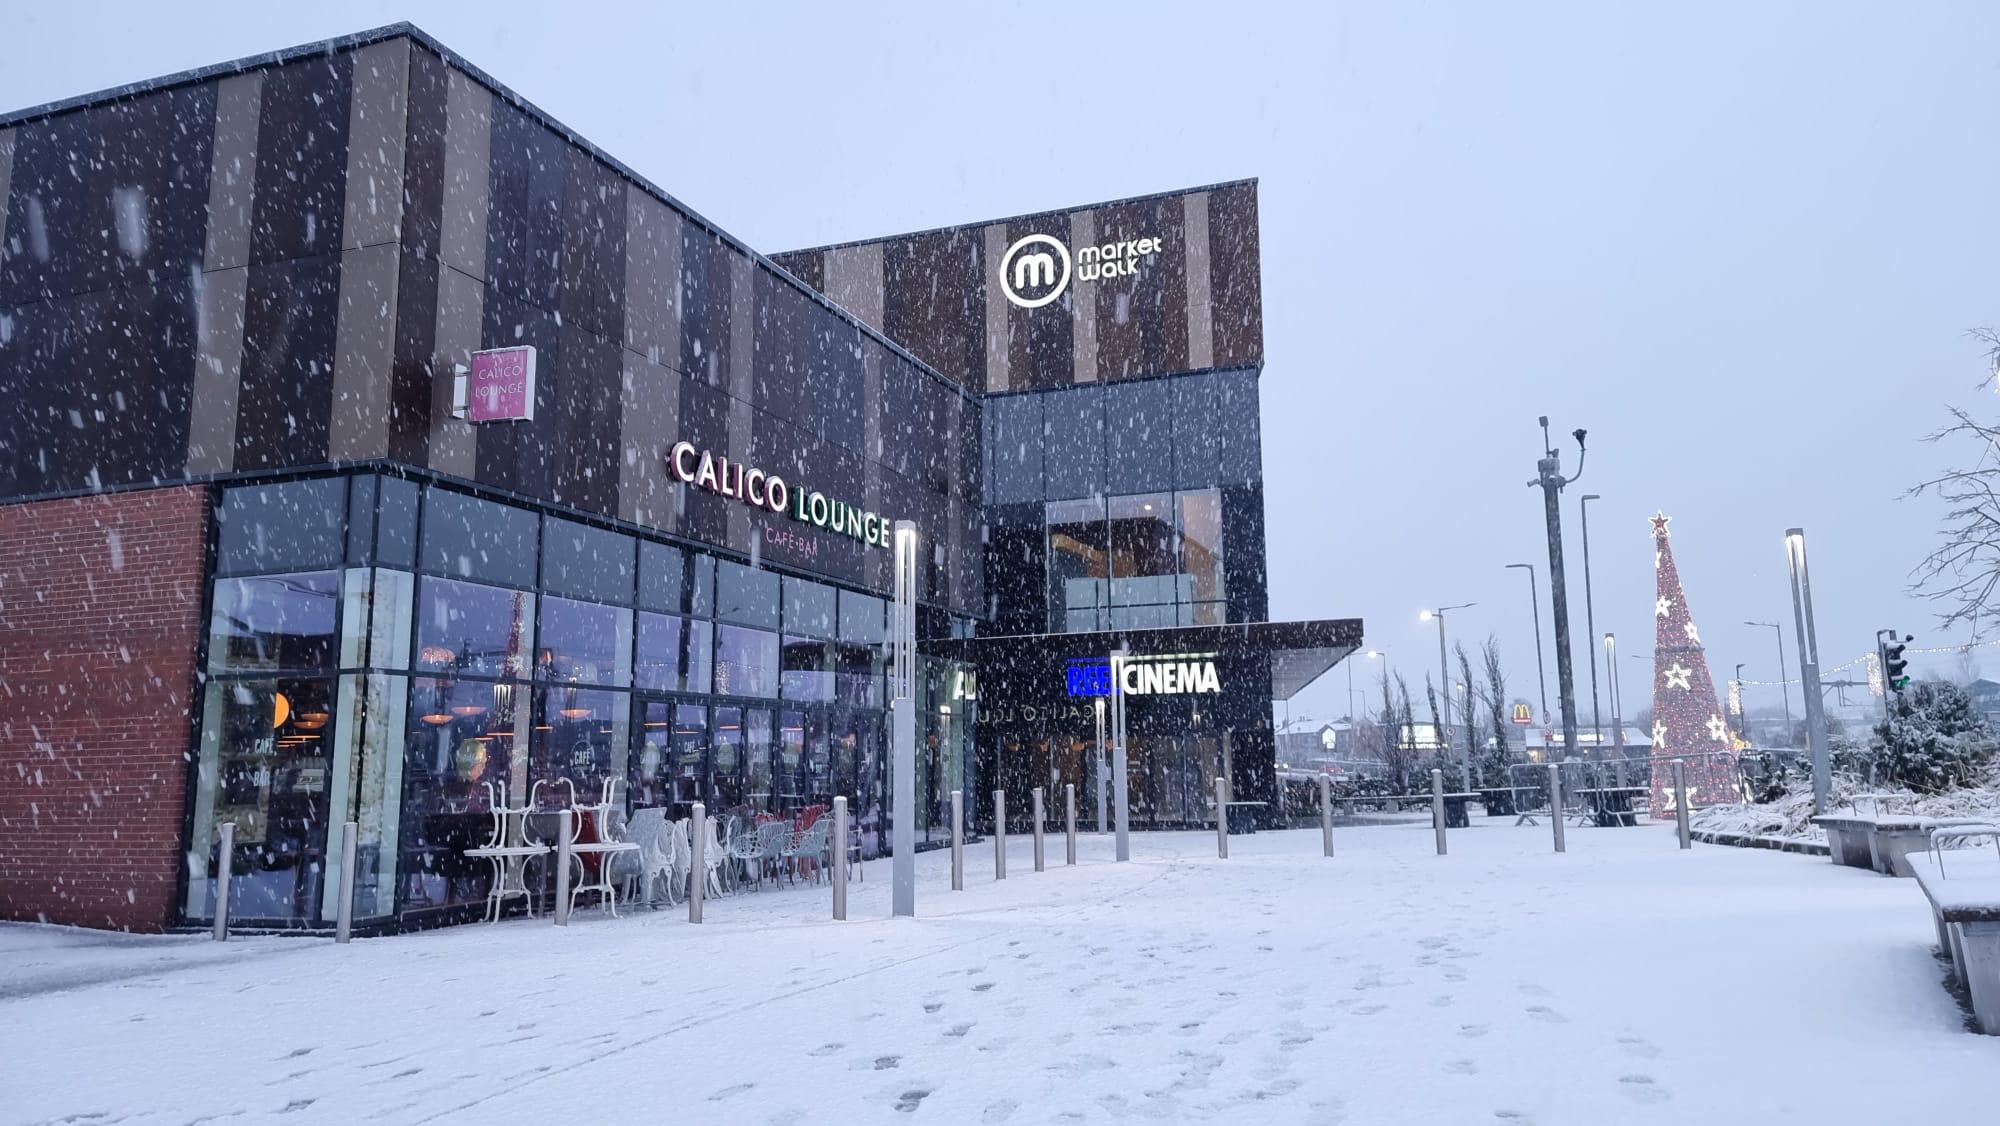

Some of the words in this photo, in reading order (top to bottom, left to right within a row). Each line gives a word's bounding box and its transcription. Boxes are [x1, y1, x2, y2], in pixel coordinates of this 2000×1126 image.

[1078, 236, 1163, 264] market
[1078, 256, 1140, 282] walk
[478, 365, 522, 380] CALICO
[475, 382, 524, 399] LOUNGE
[670, 441, 788, 513] CALICO
[794, 485, 890, 549] LOUNGE
[1123, 661, 1221, 695] CINEMA
